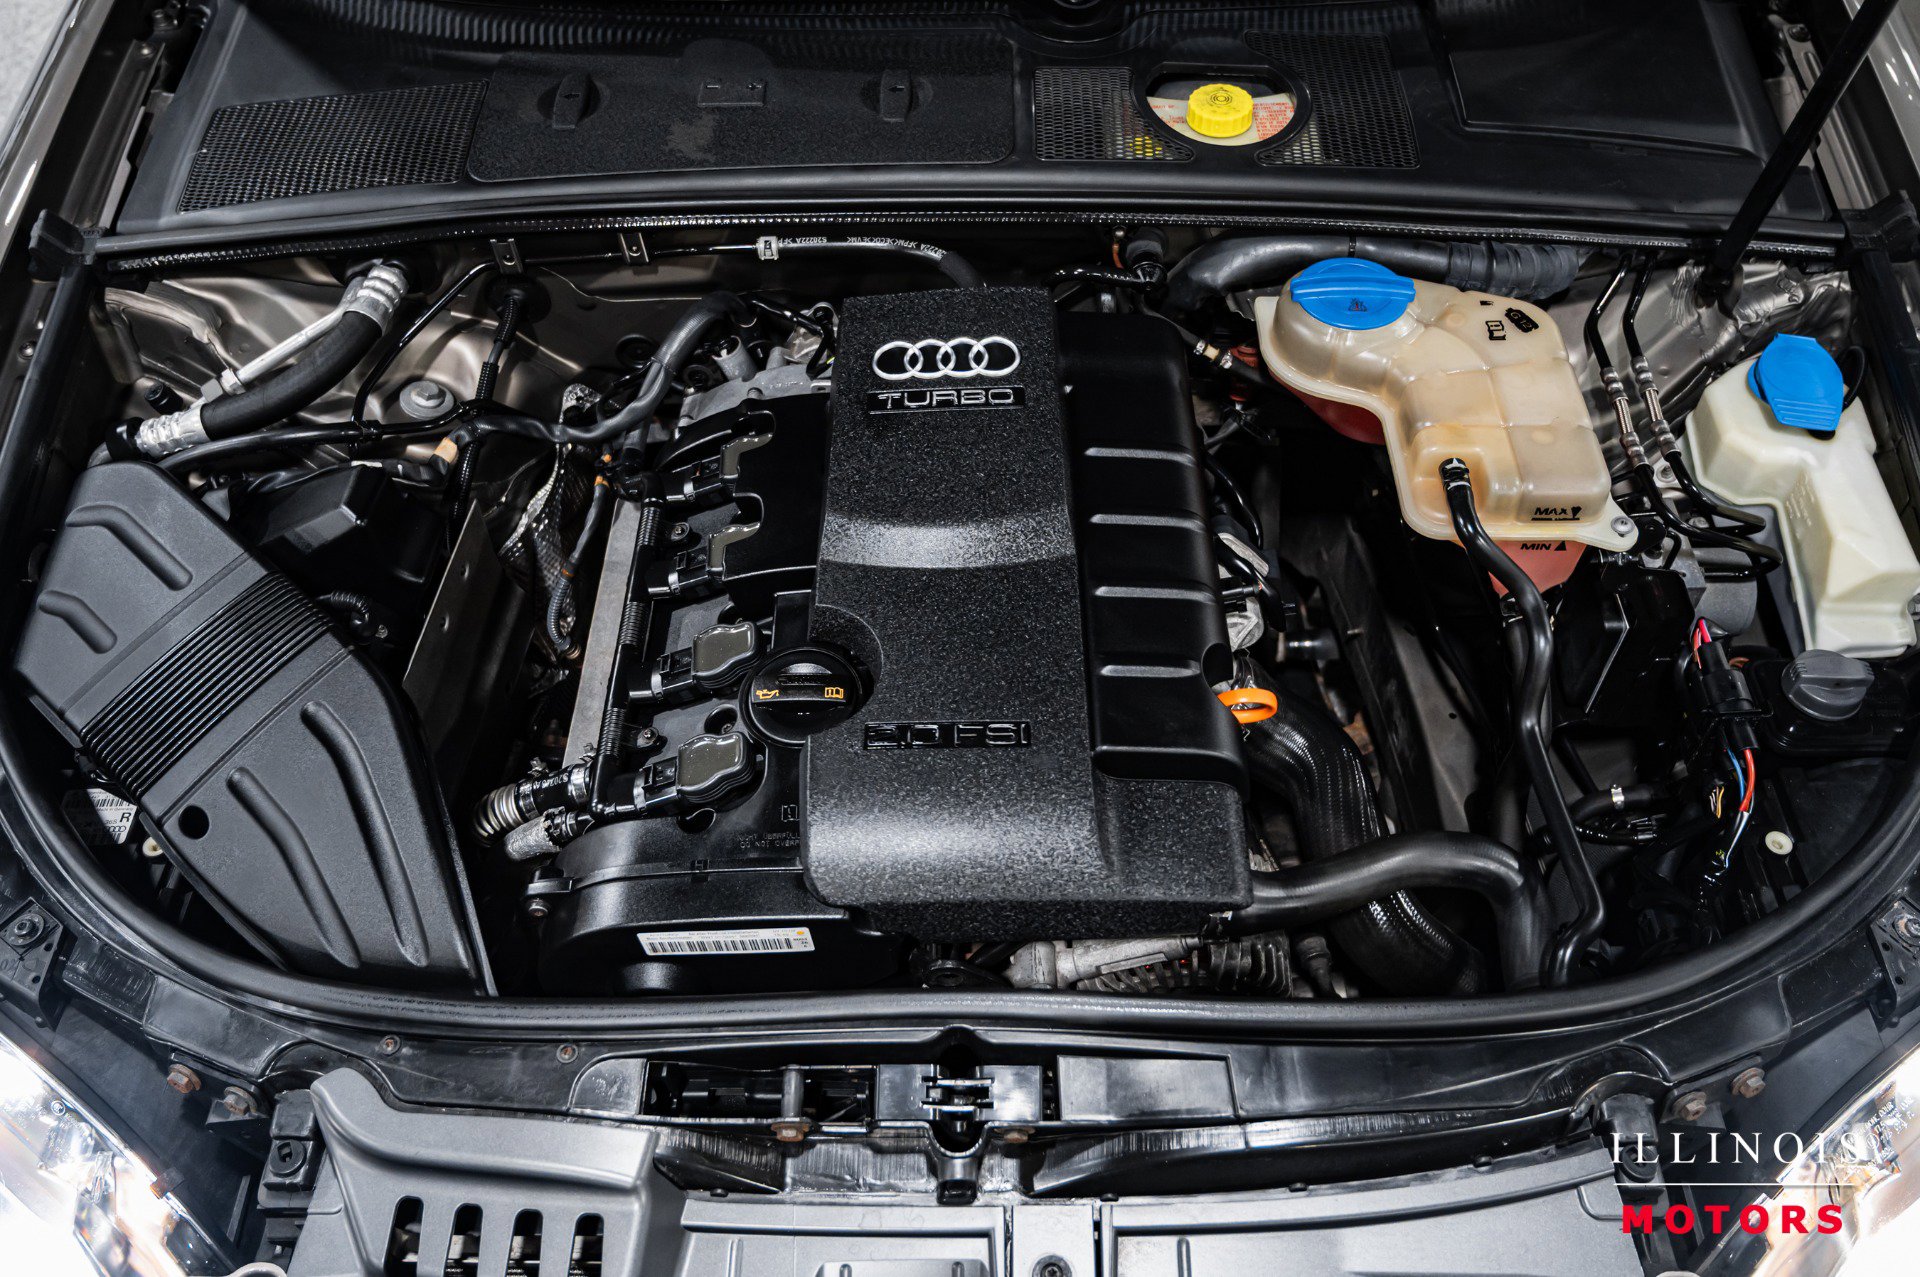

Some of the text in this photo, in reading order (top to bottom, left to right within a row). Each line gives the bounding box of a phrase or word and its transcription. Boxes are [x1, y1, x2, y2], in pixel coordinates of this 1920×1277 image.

[877, 388, 1014, 409] TURBO
[1534, 506, 1568, 516] MAX
[1520, 543, 1552, 551] MIN
[866, 722, 1029, 749] 2.0 FSI
[119, 812, 132, 823] R
